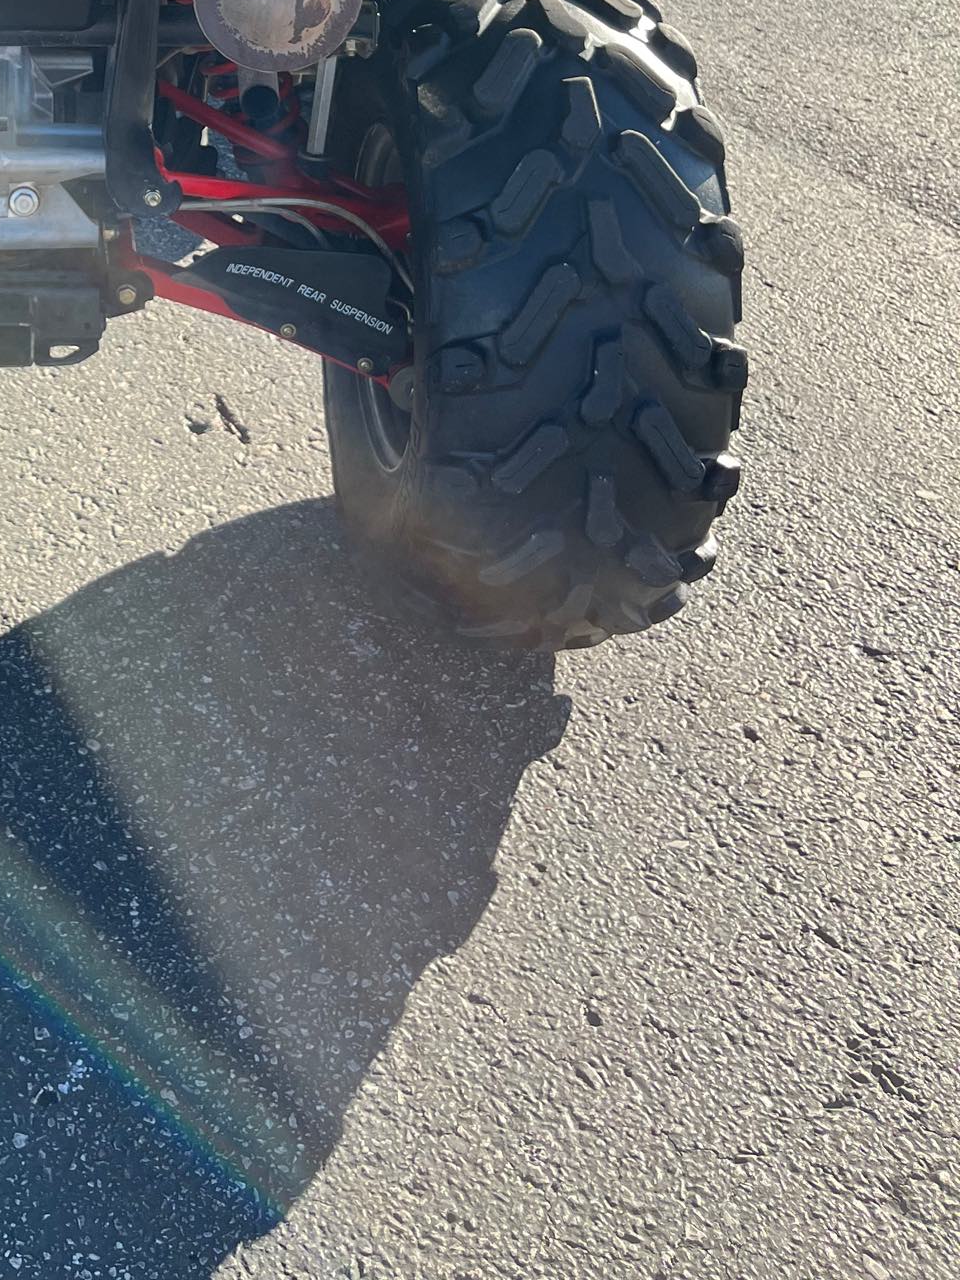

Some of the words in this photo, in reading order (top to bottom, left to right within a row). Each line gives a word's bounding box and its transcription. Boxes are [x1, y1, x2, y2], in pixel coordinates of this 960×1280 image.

[226, 263, 295, 288] INDEPENDENT
[297, 284, 327, 304] REAR
[329, 299, 394, 335] SUSPENSION
